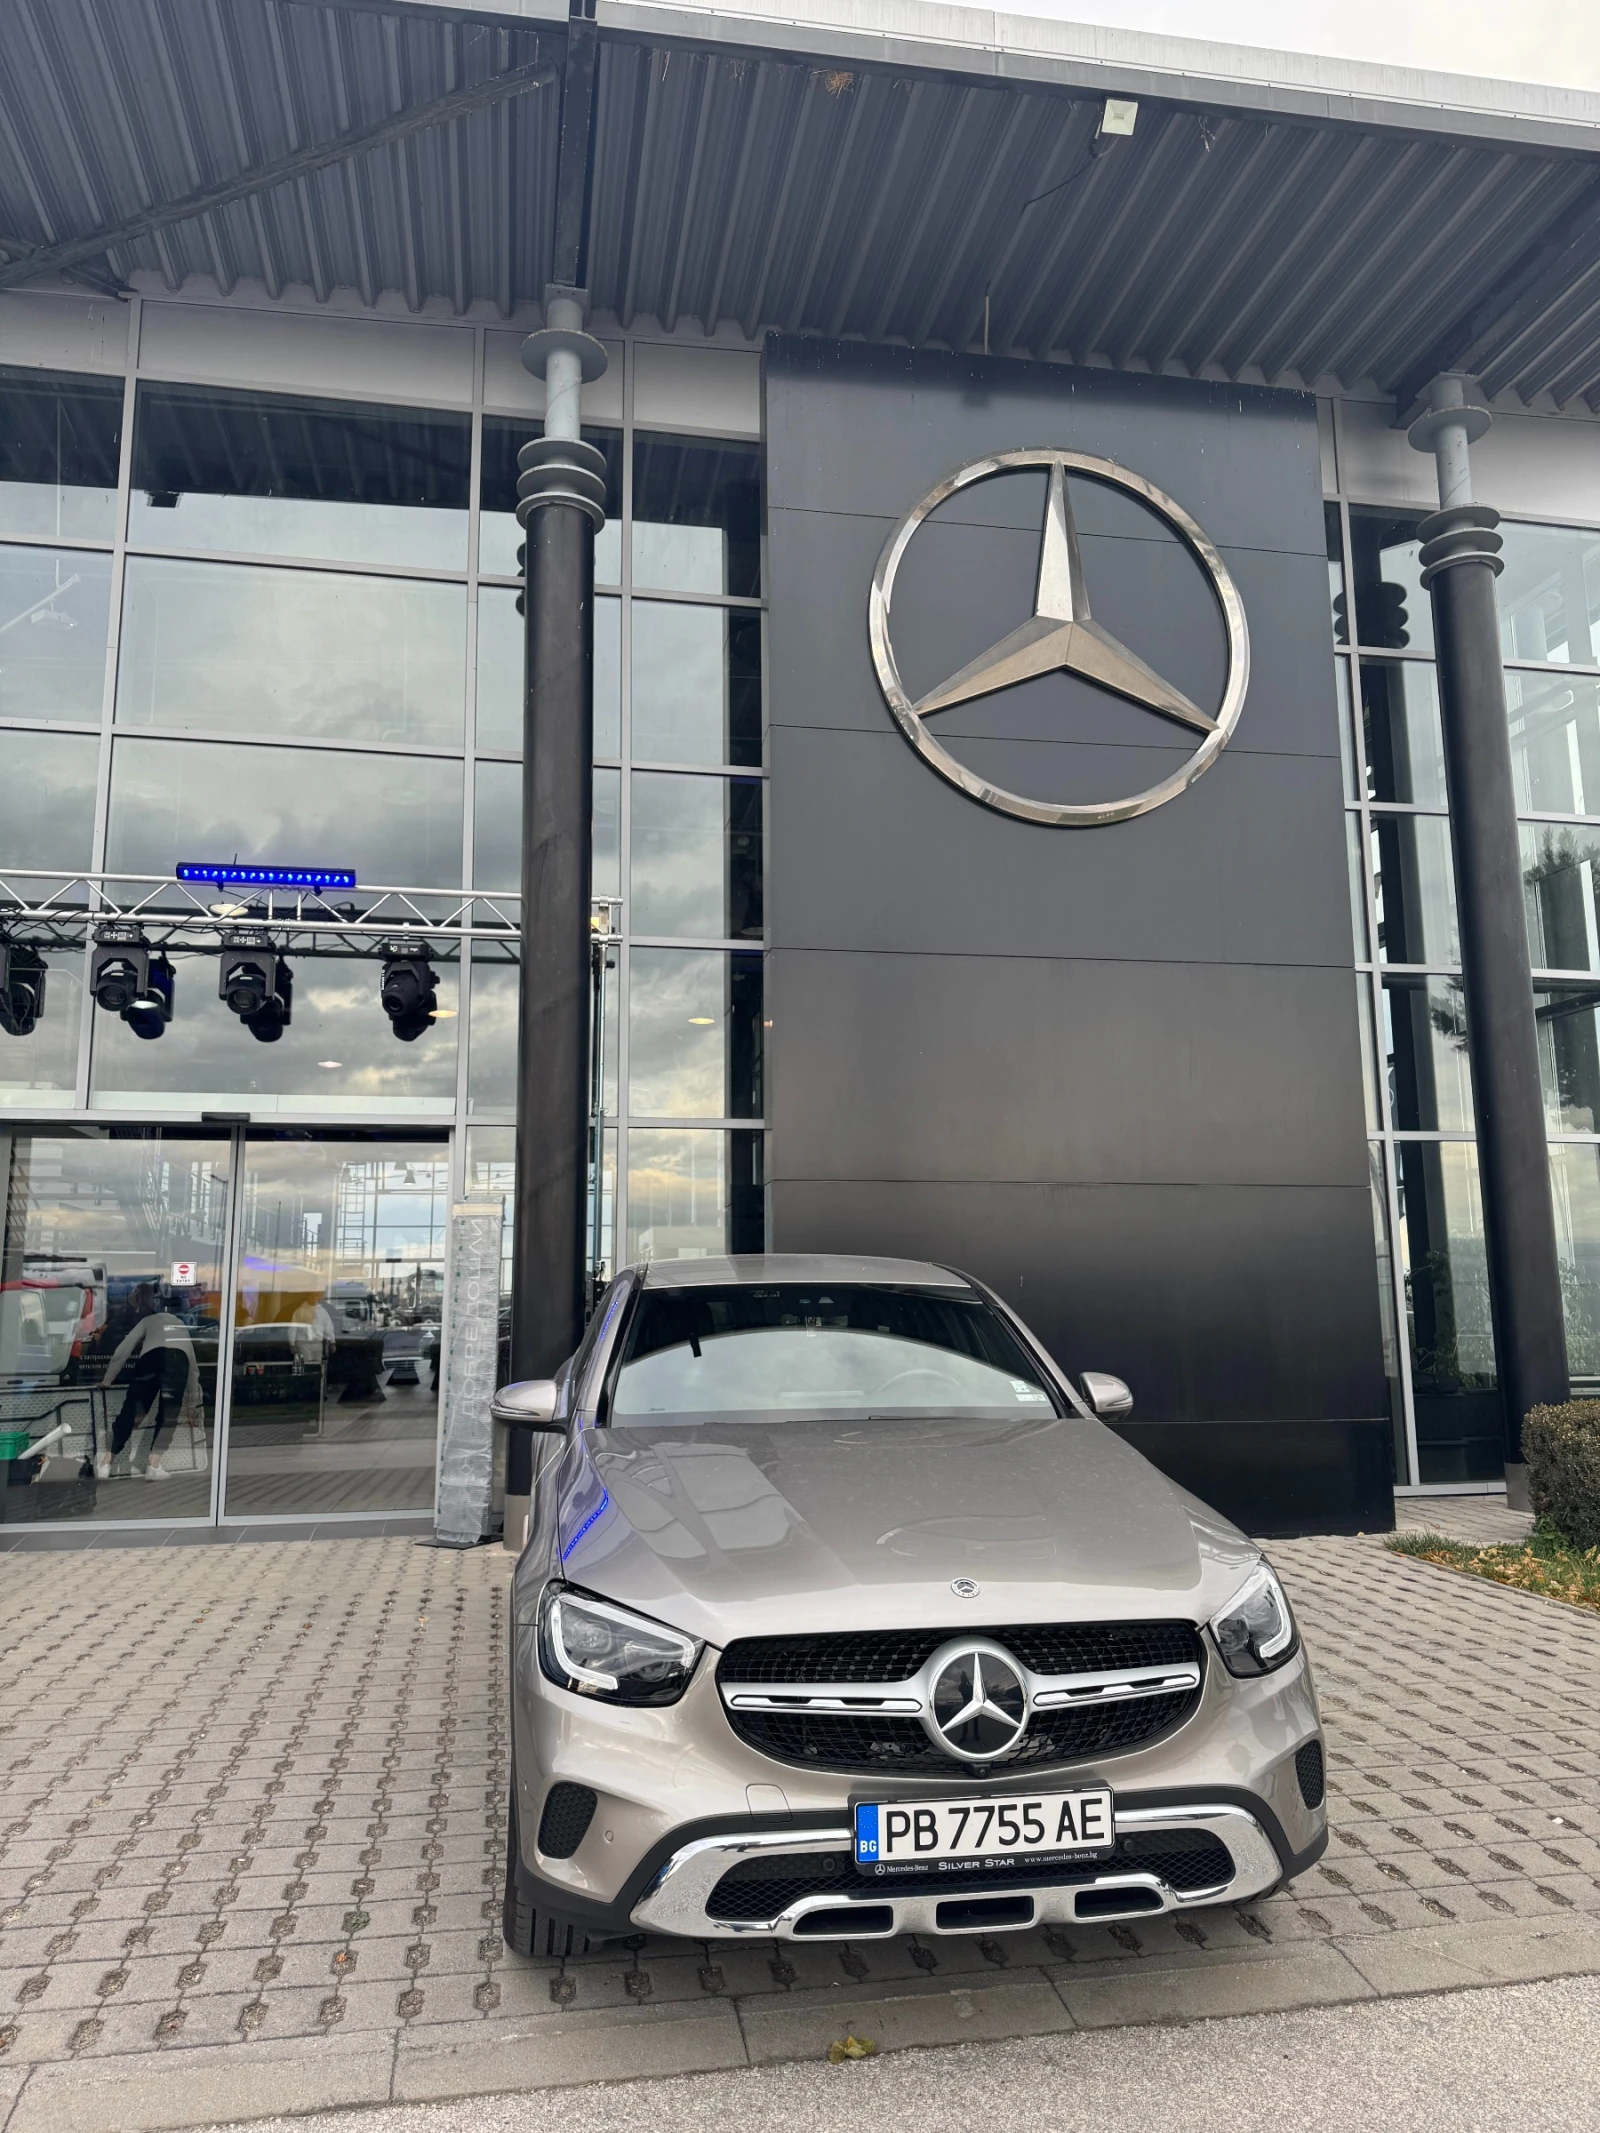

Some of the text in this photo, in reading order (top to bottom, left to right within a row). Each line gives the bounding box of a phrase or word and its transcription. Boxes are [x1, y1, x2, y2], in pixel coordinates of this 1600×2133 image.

[462, 1218, 483, 1418] ДОБРЕ ДОШЛИ
[886, 1798, 1105, 1853] PB 7755 AE
[860, 1840, 877, 1853] BG
[1024, 1850, 1098, 1863] www.mercedes-benz.bg
[886, 1864, 929, 1873] Mercedes-Benz
[938, 1858, 1015, 1870] SILVER STAR
